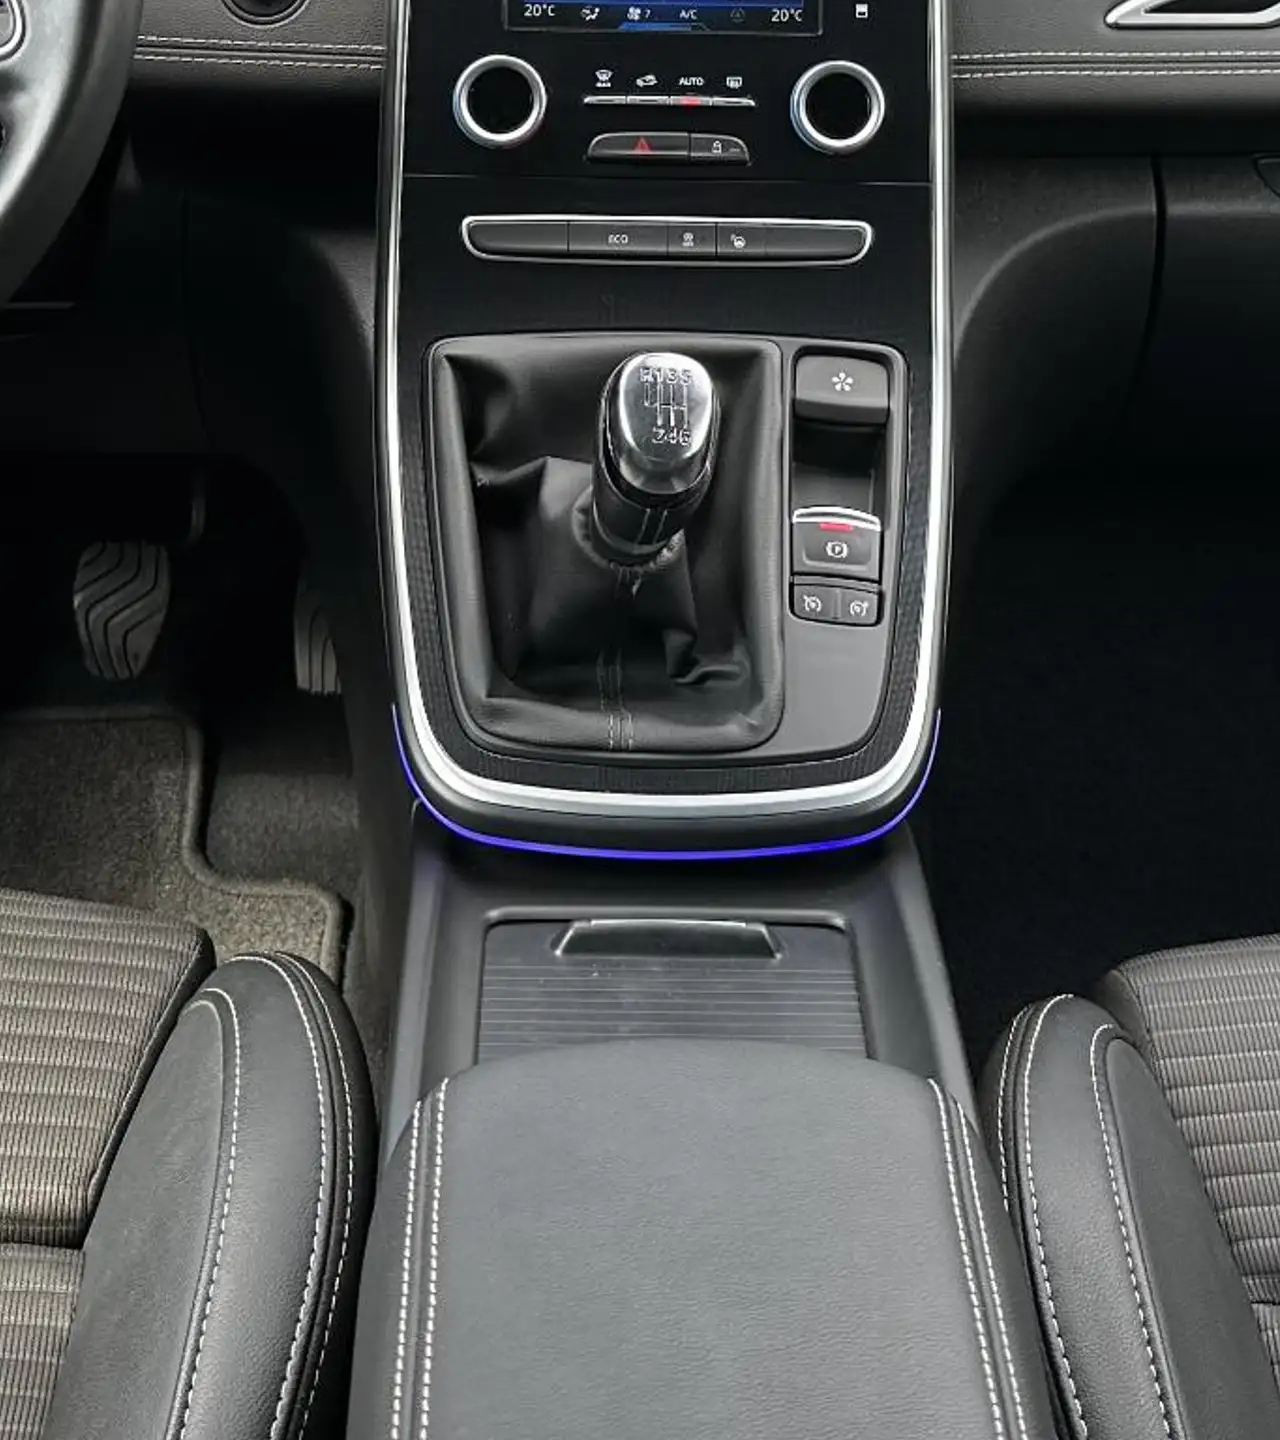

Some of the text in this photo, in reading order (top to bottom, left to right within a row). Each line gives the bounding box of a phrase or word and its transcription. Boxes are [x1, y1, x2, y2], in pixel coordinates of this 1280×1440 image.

[524, 4, 556, 17] 20°C
[771, 9, 802, 22] 20°C
[679, 77, 705, 86] AUTO
